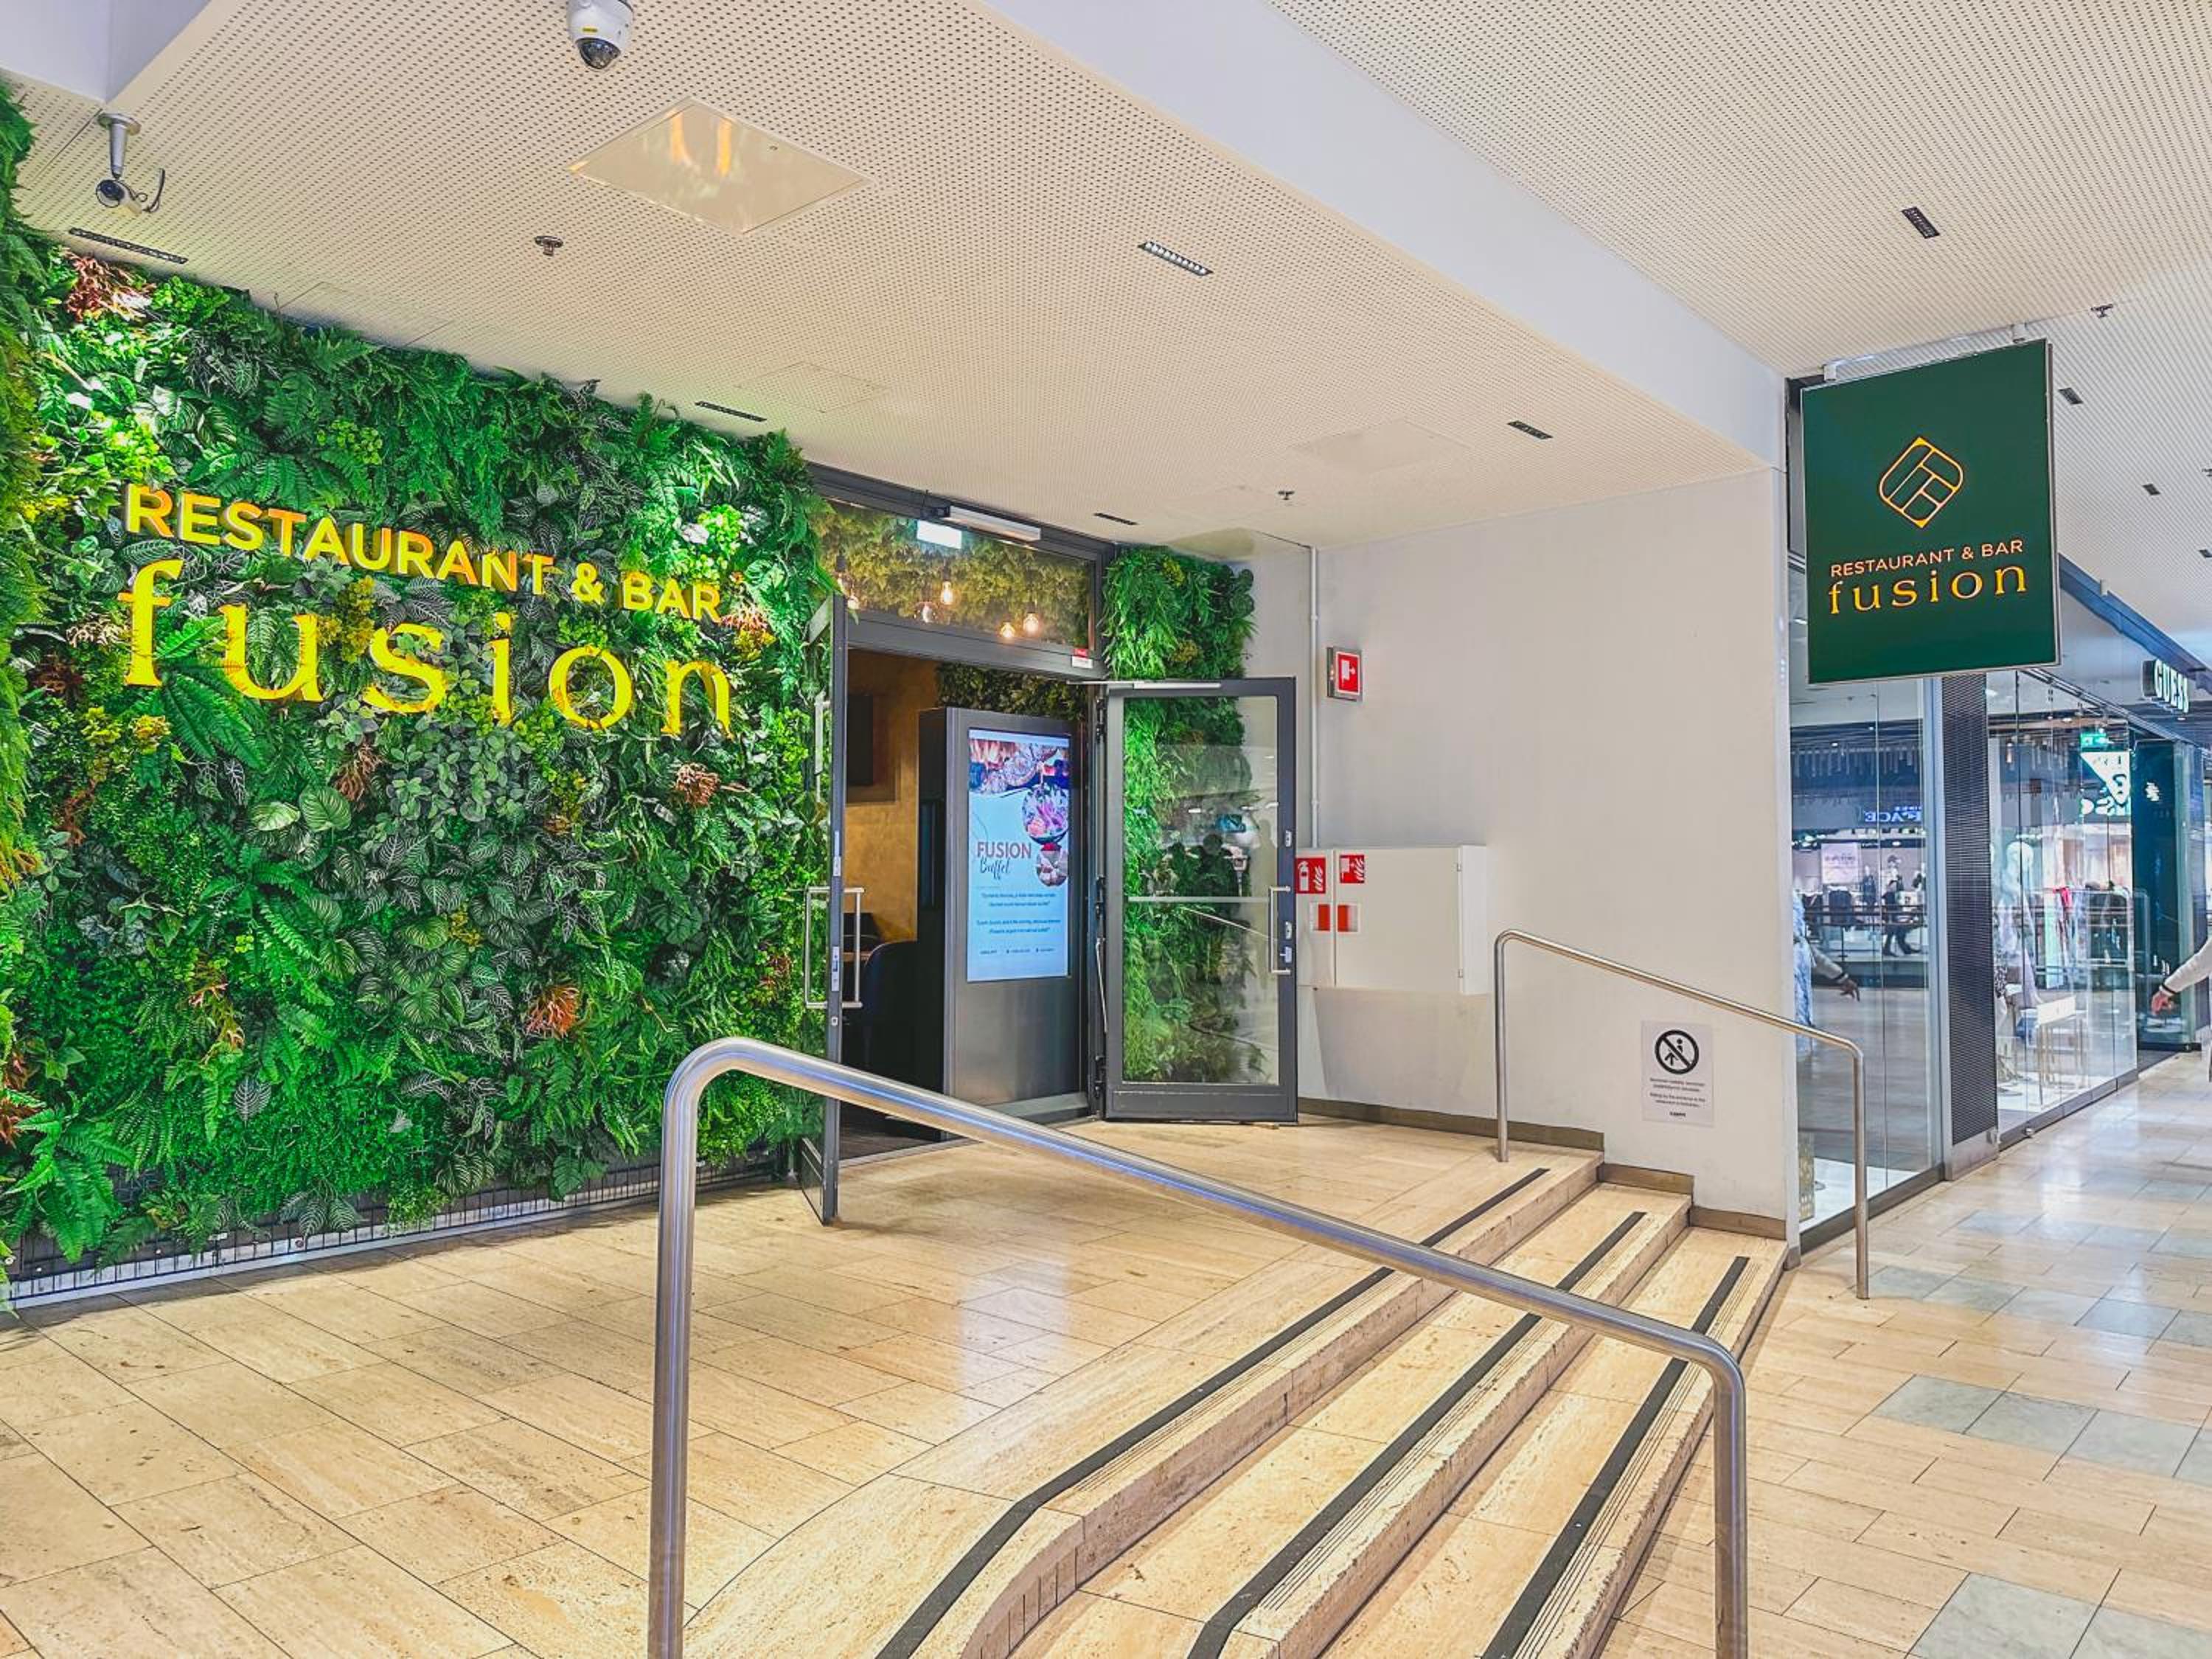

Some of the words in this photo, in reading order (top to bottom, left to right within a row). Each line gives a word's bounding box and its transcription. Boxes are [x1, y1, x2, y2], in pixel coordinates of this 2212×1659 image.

[124, 483, 555, 597] RESTAURANT
[570, 561, 605, 605] &
[619, 570, 724, 624] BAR
[1829, 549, 1955, 577] RESTAURANT
[1961, 546, 1975, 560] &
[1981, 539, 2024, 557] BAR
[1829, 565, 2027, 614] fusion
[118, 558, 735, 741] fusion
[2154, 658, 2189, 714] GUESS
[977, 841, 1032, 859] FUSION
